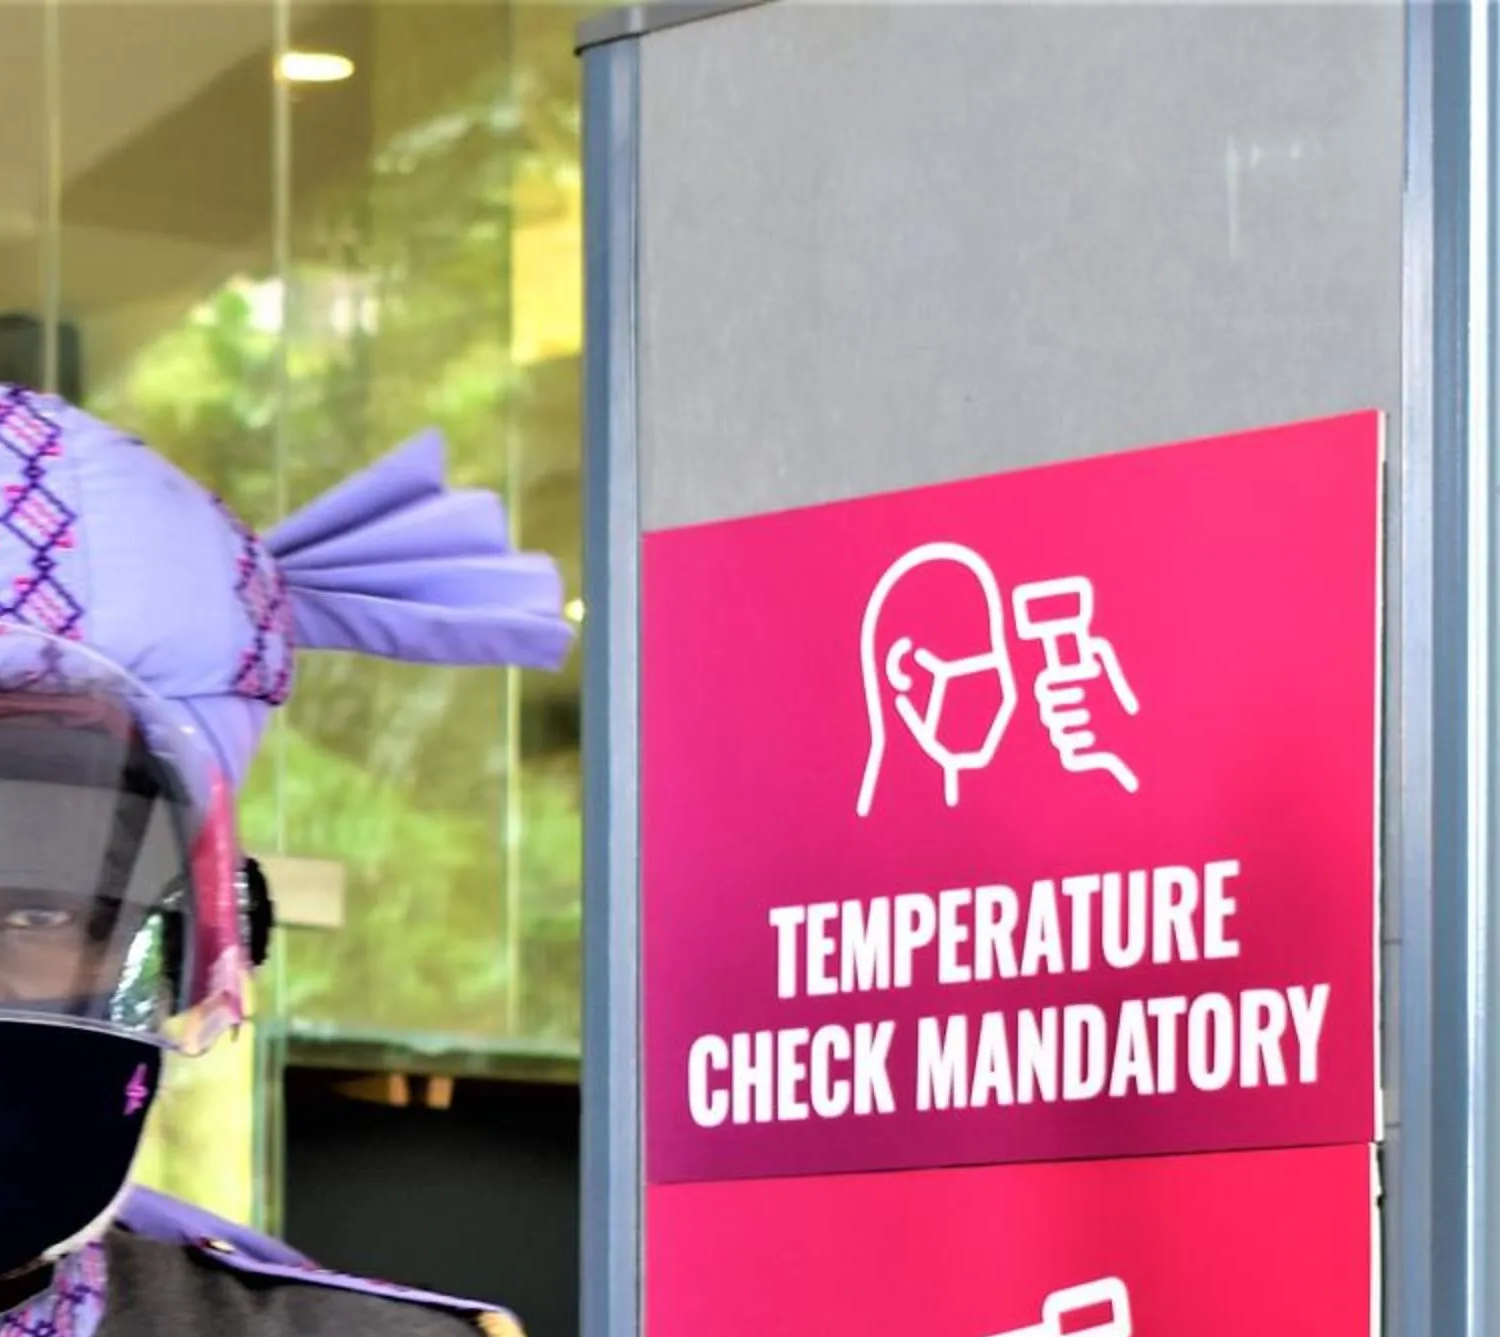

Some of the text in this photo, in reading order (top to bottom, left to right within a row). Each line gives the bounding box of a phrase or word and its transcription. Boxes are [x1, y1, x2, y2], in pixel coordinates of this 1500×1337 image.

[769, 859, 1240, 999] TEMPERATURE
[688, 983, 1331, 1127] CHECK MANDATORY
